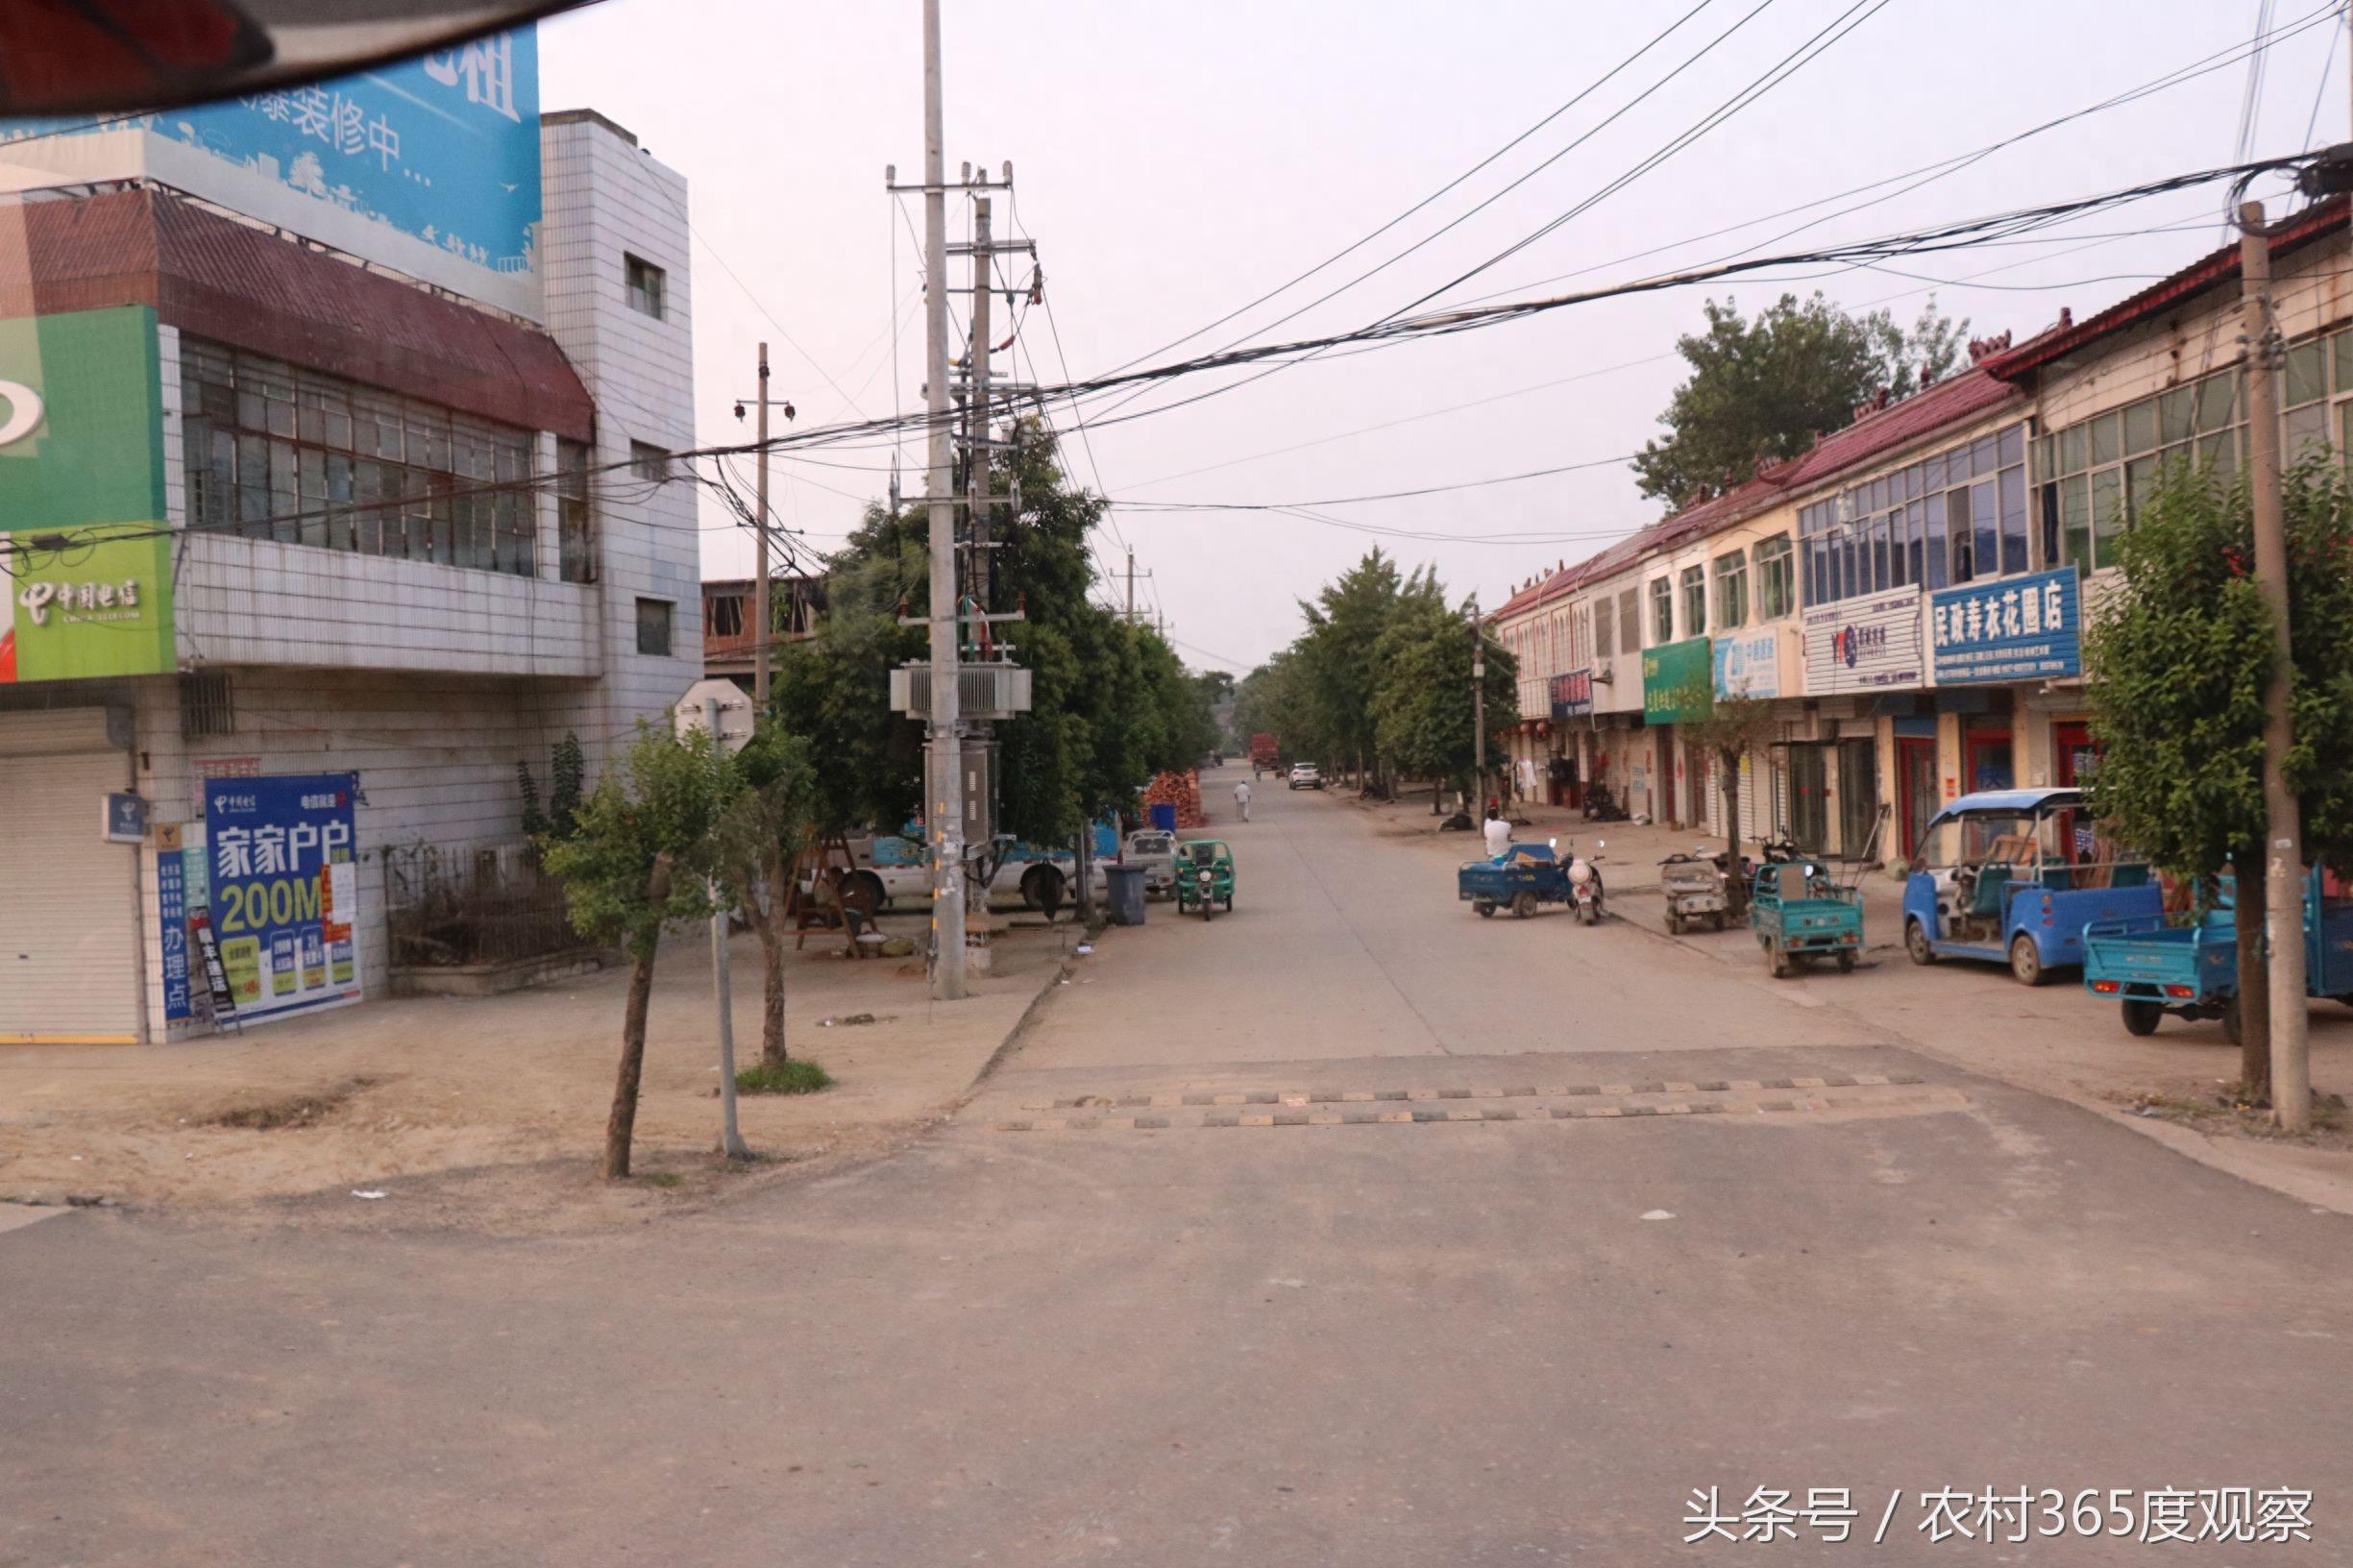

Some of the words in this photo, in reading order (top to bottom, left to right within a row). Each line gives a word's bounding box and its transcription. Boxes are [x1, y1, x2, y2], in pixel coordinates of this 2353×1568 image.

[424, 32, 521, 123] 租
[58, 579, 138, 610] 中国电信
[1935, 578, 2062, 648] 民政寿衣花圈店
[217, 820, 350, 878] 家家户户
[220, 875, 323, 933] 200M
[164, 924, 187, 1010] 办理点
